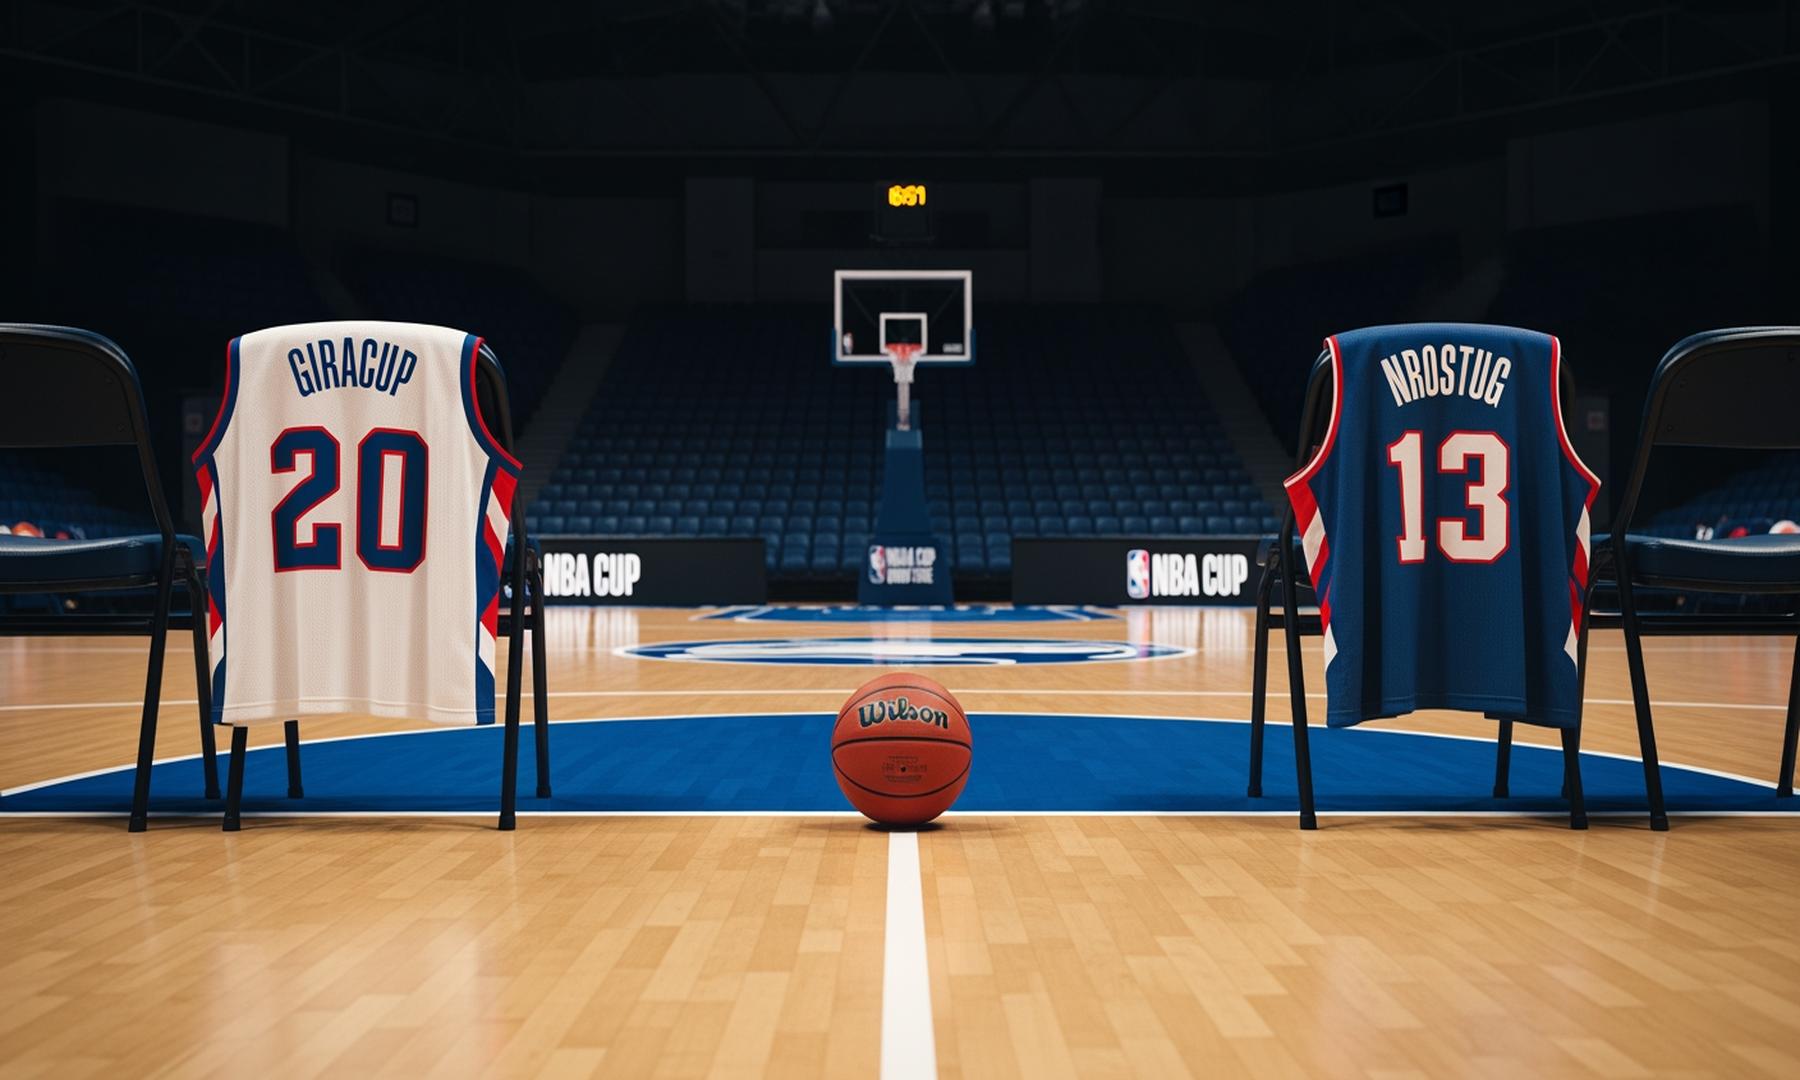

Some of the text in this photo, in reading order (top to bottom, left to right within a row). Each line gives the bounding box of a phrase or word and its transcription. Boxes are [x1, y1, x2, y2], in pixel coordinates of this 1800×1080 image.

[287, 337, 418, 397] GIRACUP
[1380, 343, 1512, 408] NROSTUG
[270, 425, 429, 574] 20
[1386, 429, 1511, 564] 13
[543, 552, 641, 597] NBA CUP
[1151, 553, 1248, 597] NBA CUP
[858, 696, 948, 729] Wilson
